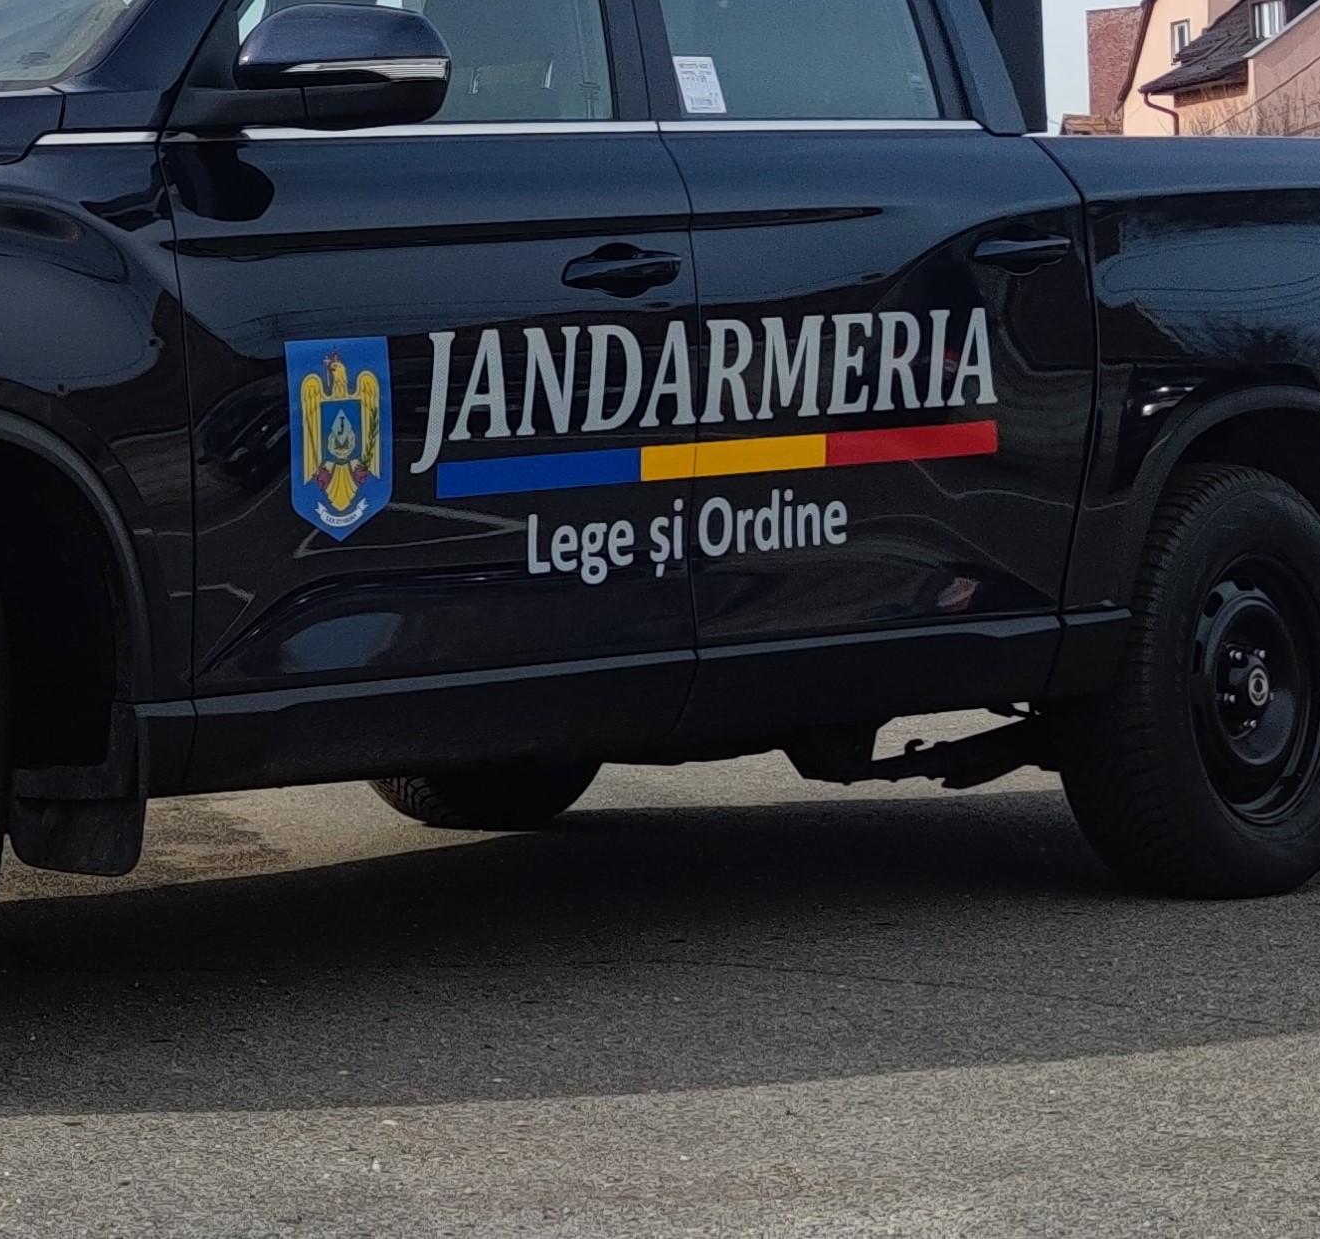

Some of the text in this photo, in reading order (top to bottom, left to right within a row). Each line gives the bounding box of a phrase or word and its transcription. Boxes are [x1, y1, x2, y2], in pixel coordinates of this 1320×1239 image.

[410, 307, 998, 474] JANDARMERIA
[526, 489, 849, 585] Lege și Ordine
